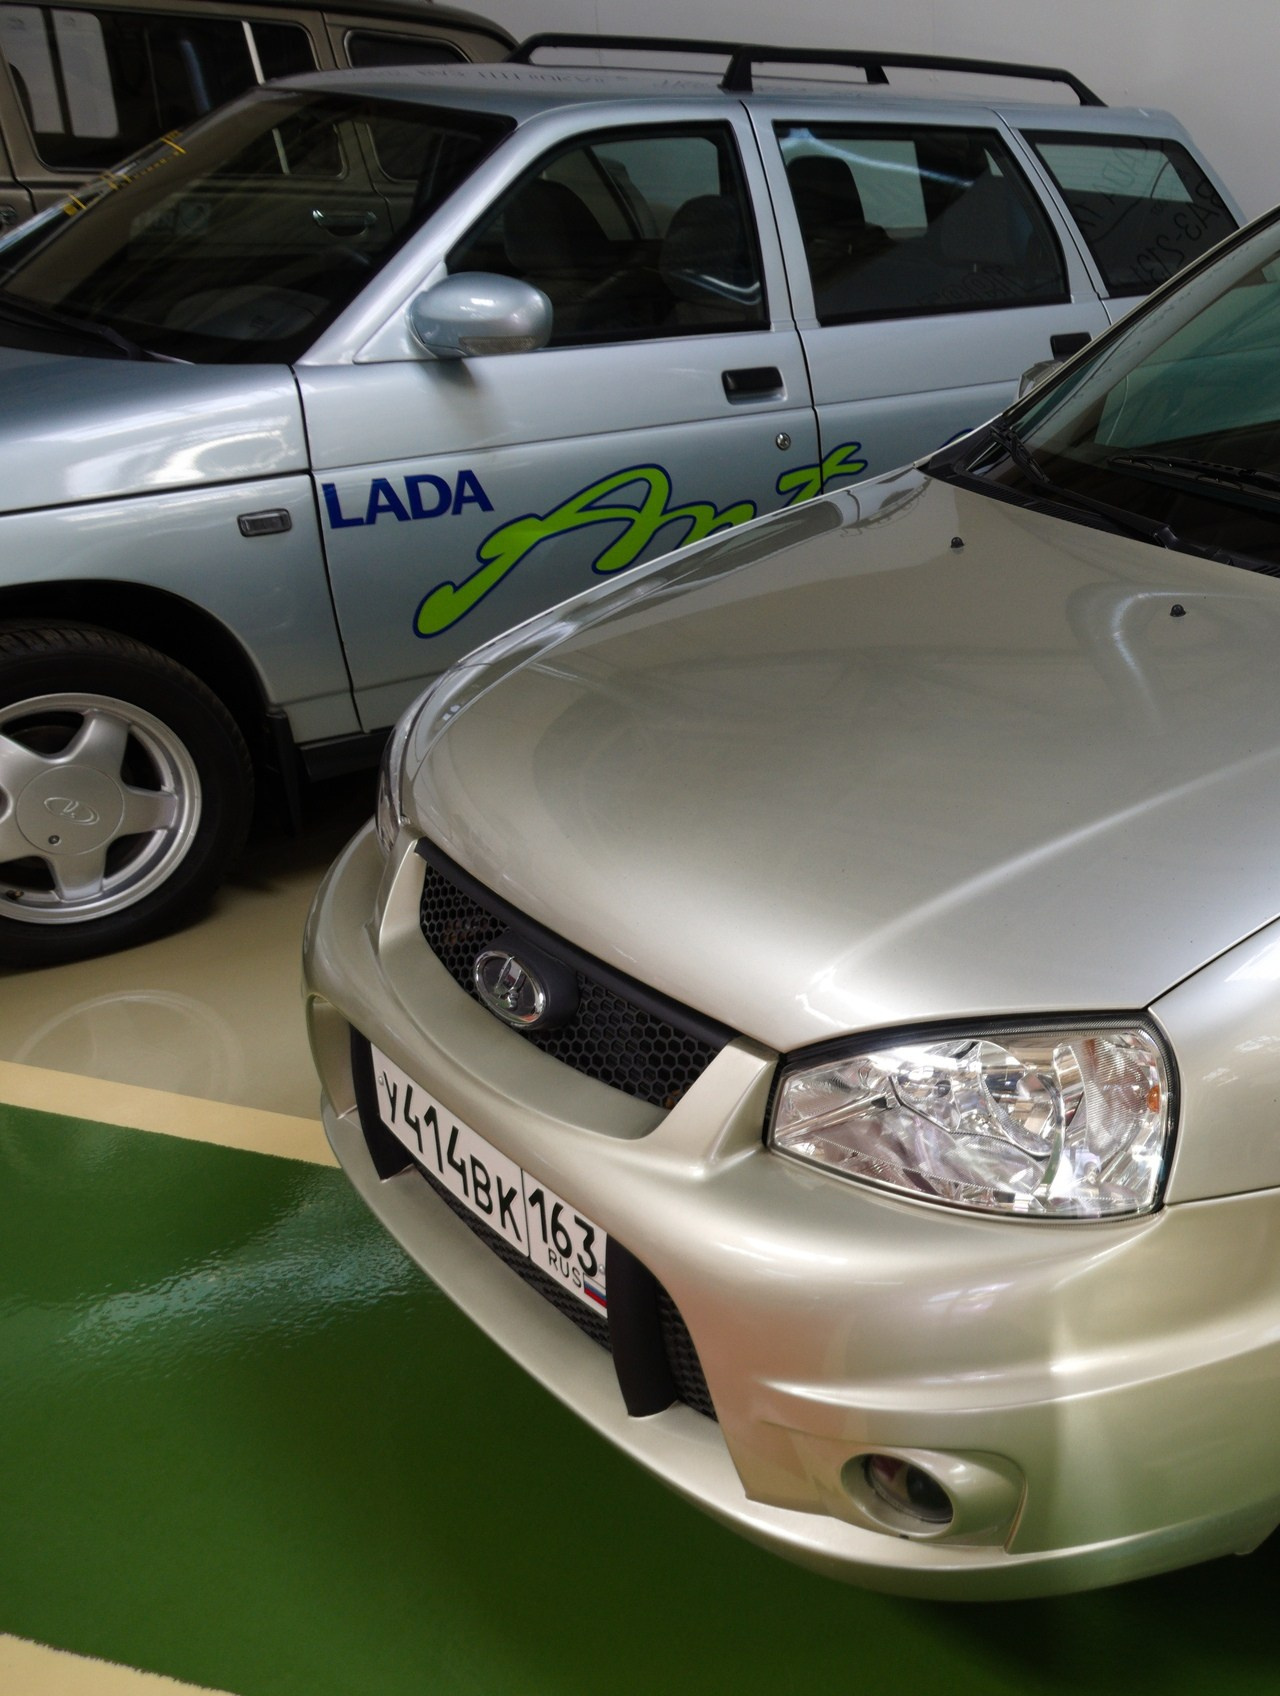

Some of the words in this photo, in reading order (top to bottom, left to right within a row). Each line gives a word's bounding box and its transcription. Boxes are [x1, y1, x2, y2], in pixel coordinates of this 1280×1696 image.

[321, 469, 494, 529] LADA
[528, 1187, 599, 1279] 163
[547, 1248, 583, 1289] RUS
